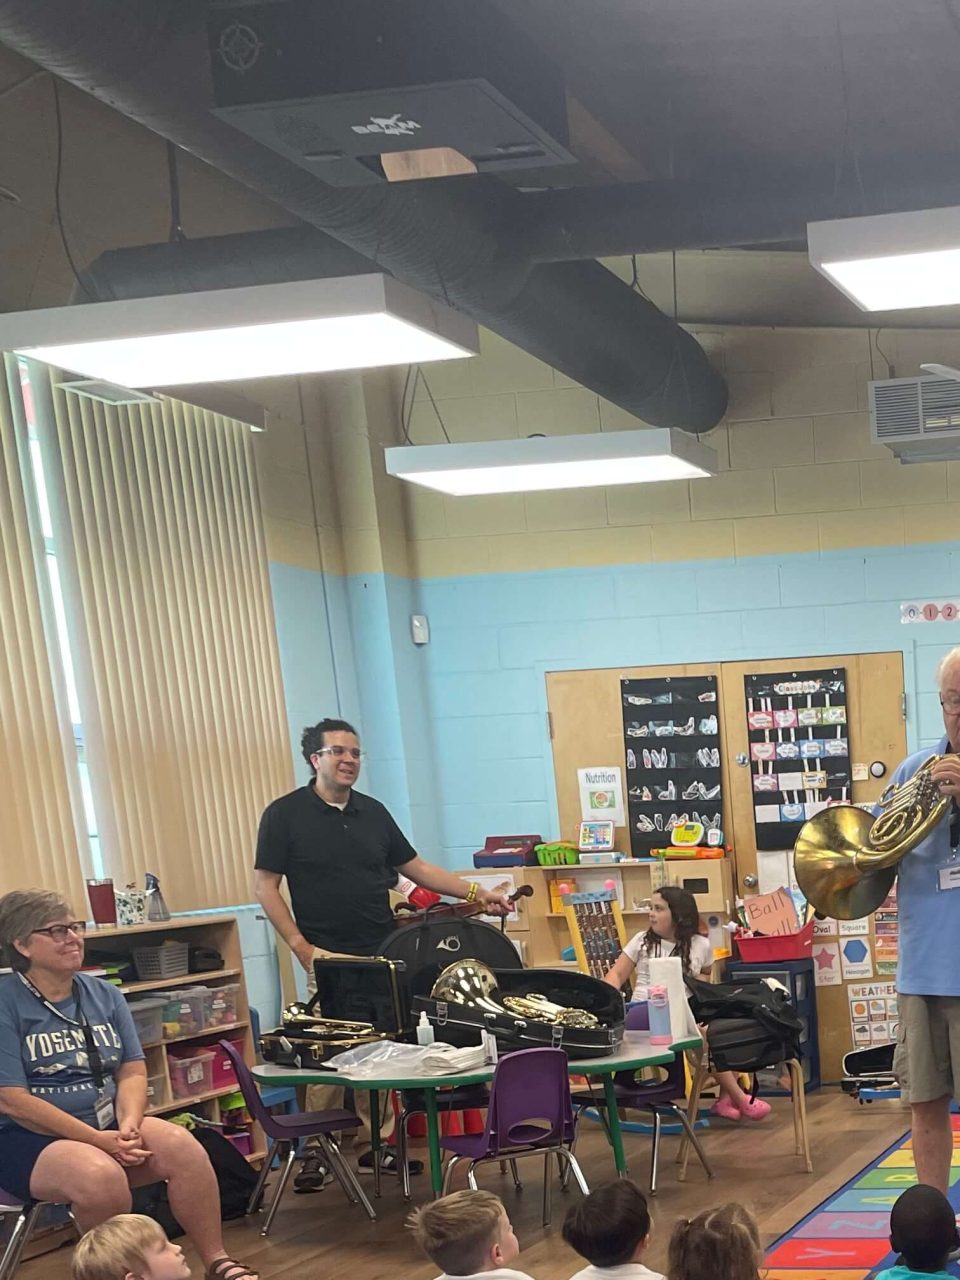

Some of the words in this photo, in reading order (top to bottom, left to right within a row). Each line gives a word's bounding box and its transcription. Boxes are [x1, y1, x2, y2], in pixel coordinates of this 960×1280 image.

[585, 771, 617, 784] Nutrition
[748, 892, 785, 920] Ball
[813, 925, 831, 934] Oval
[841, 923, 867, 933] Square
[25, 1022, 122, 1062] YOSEMITE
[795, 1247, 857, 1261] Y
